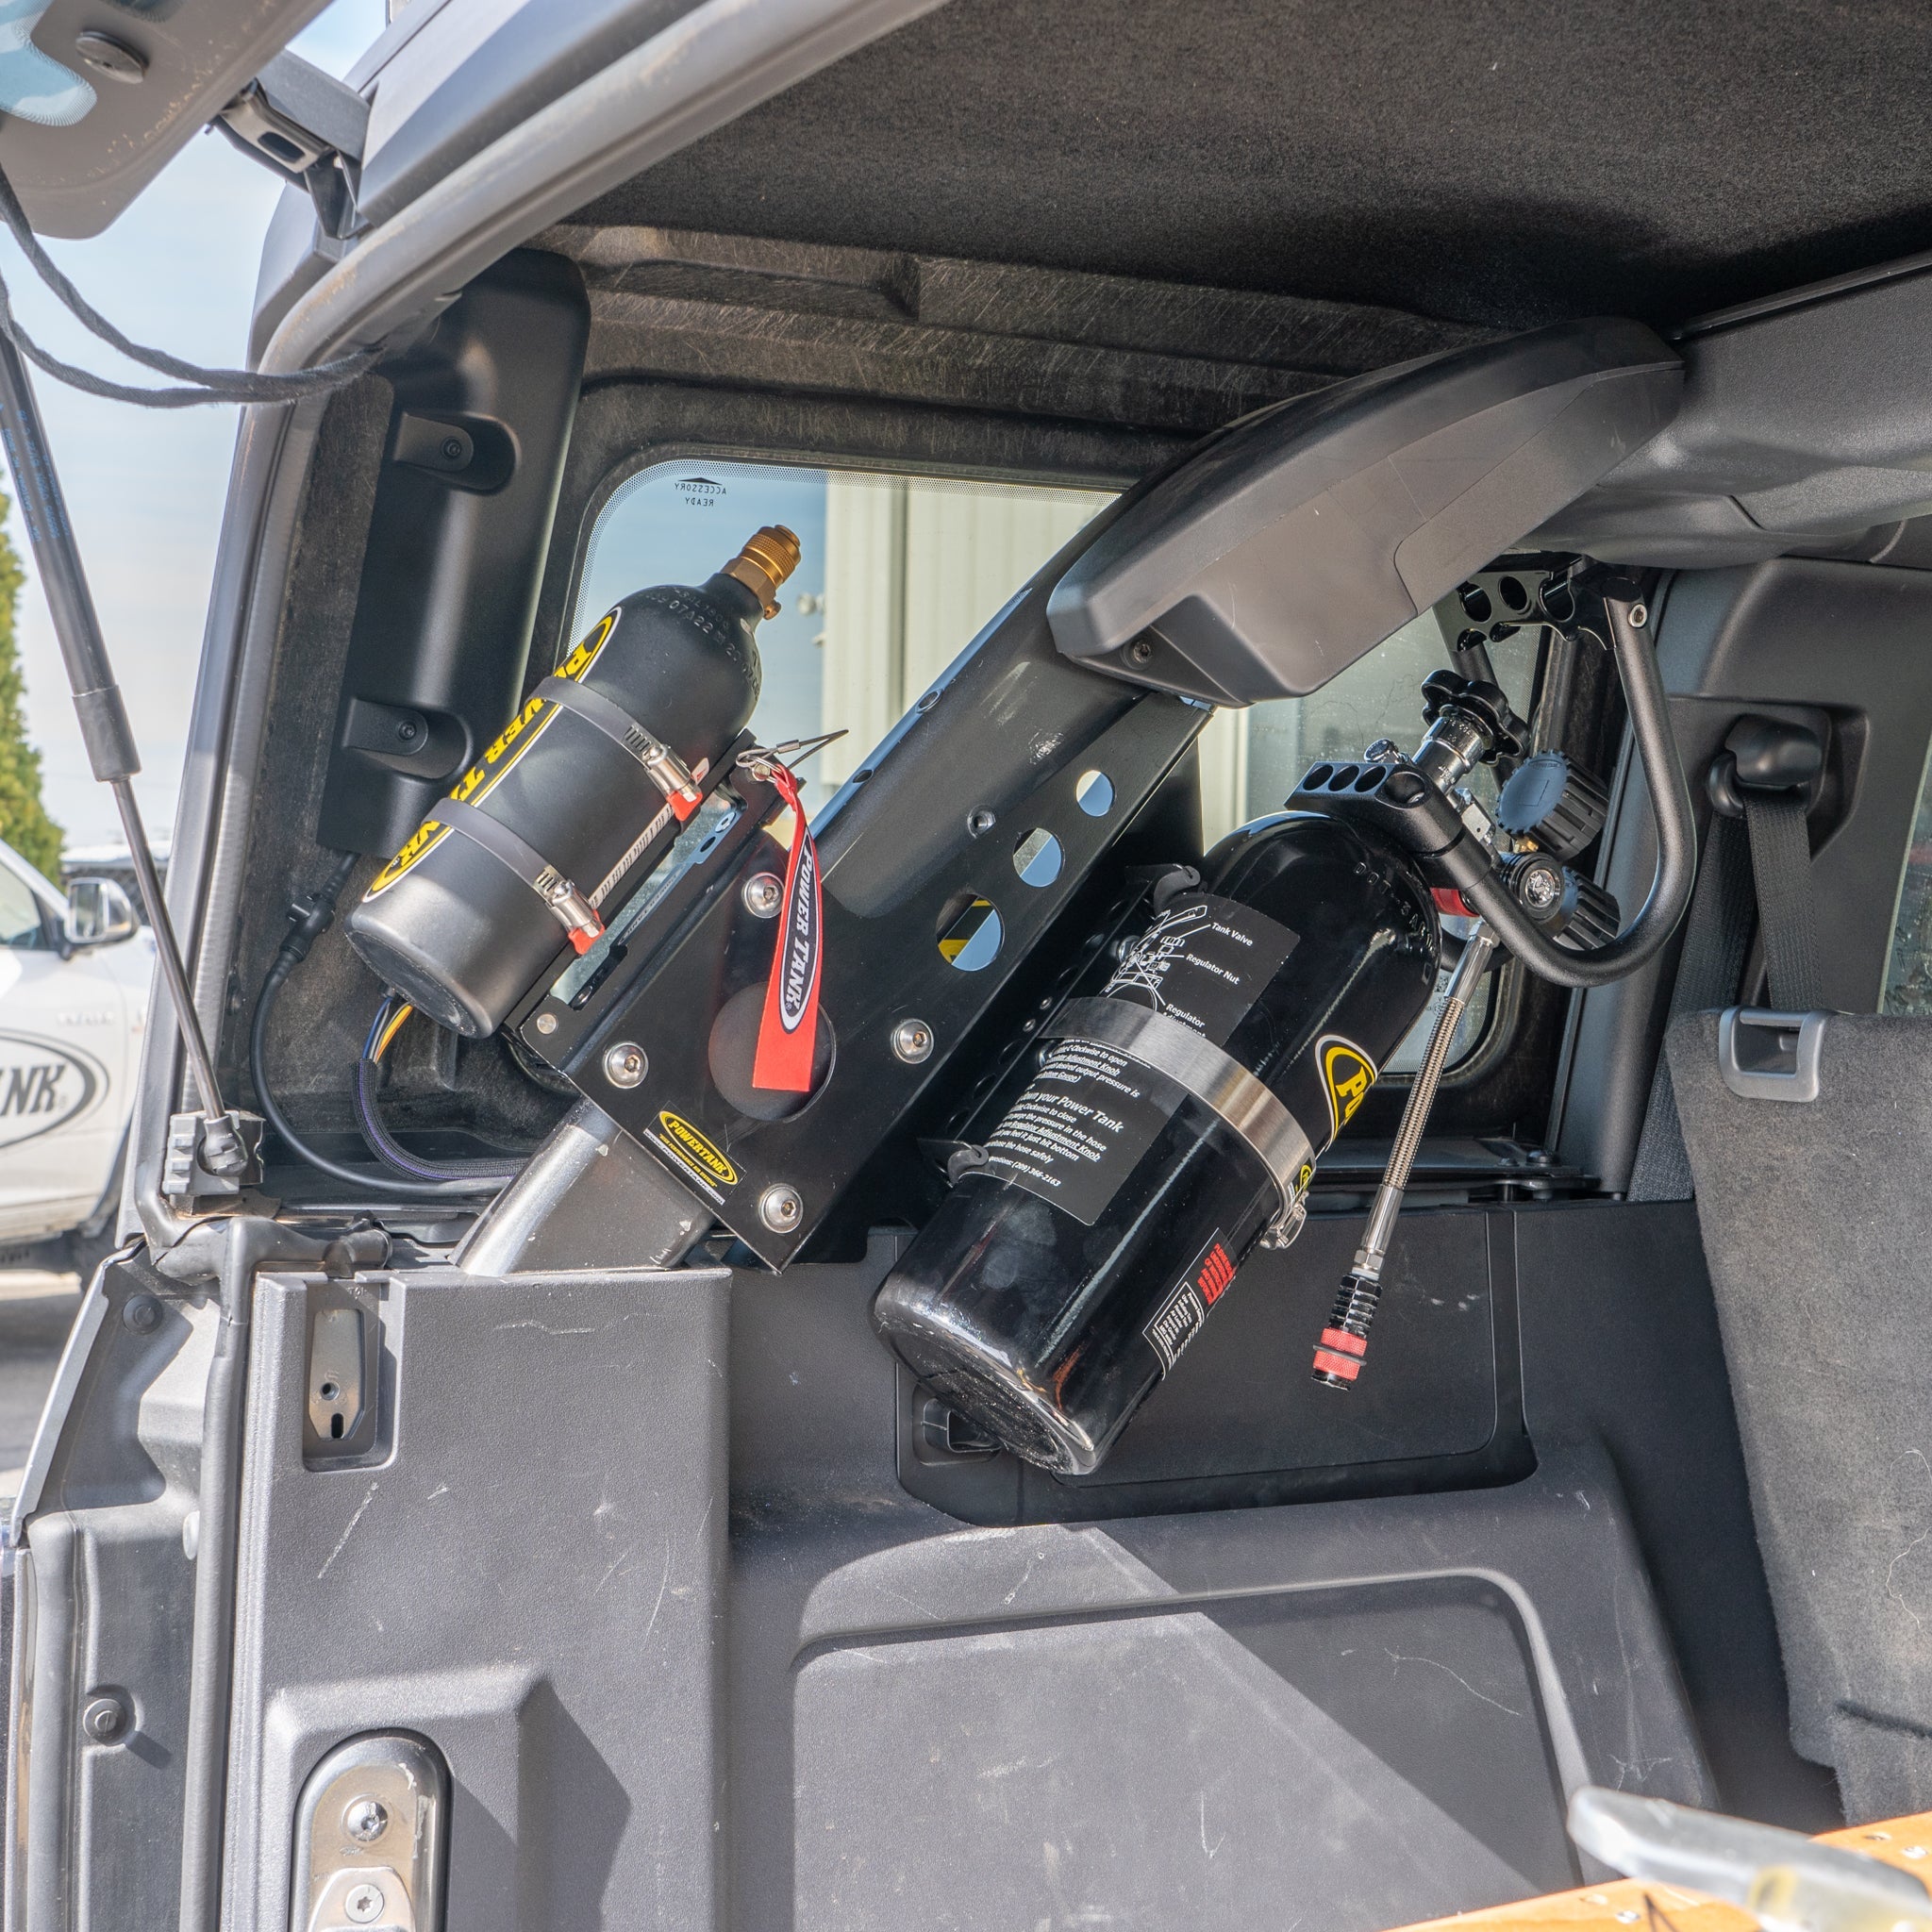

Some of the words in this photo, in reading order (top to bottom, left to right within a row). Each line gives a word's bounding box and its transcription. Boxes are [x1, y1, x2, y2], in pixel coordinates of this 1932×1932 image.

[796, 844, 813, 936] POWER
[1211, 923, 1231, 935] Tank
[1231, 929, 1253, 946] Valve
[787, 937, 810, 1009] TANK
[1186, 954, 1224, 975] Regulator
[1223, 970, 1241, 985] Nut
[1166, 1004, 1205, 1027] Regulator
[1100, 1050, 1108, 1058] to
[1108, 1055, 1127, 1067] open
[1100, 1063, 1121, 1076] Knob
[0, 1064, 66, 1117] NK
[1075, 1065, 1098, 1078] output
[1096, 1073, 1131, 1093] pressure
[1130, 1089, 1141, 1098] is
[1035, 1092, 1060, 1103] your
[1057, 1095, 1094, 1116] Power
[1092, 1110, 1124, 1133] Tank
[1058, 1110, 1077, 1123] close
[668, 1120, 727, 1174] POWERTANK
[1025, 1133, 1041, 1143] just
[1040, 1139, 1052, 1147] hit
[1050, 1142, 1080, 1161] bottom
[1034, 1115, 1065, 1130] pressure
[1073, 1128, 1087, 1141] the
[1086, 1136, 1107, 1152] hose
[1037, 1125, 1081, 1151] Adjustment
[1078, 1144, 1102, 1161] Knob
[1014, 1143, 1032, 1155] hose
[1030, 1149, 1054, 1163] safely
[1028, 1166, 1061, 1187] 366-2163
